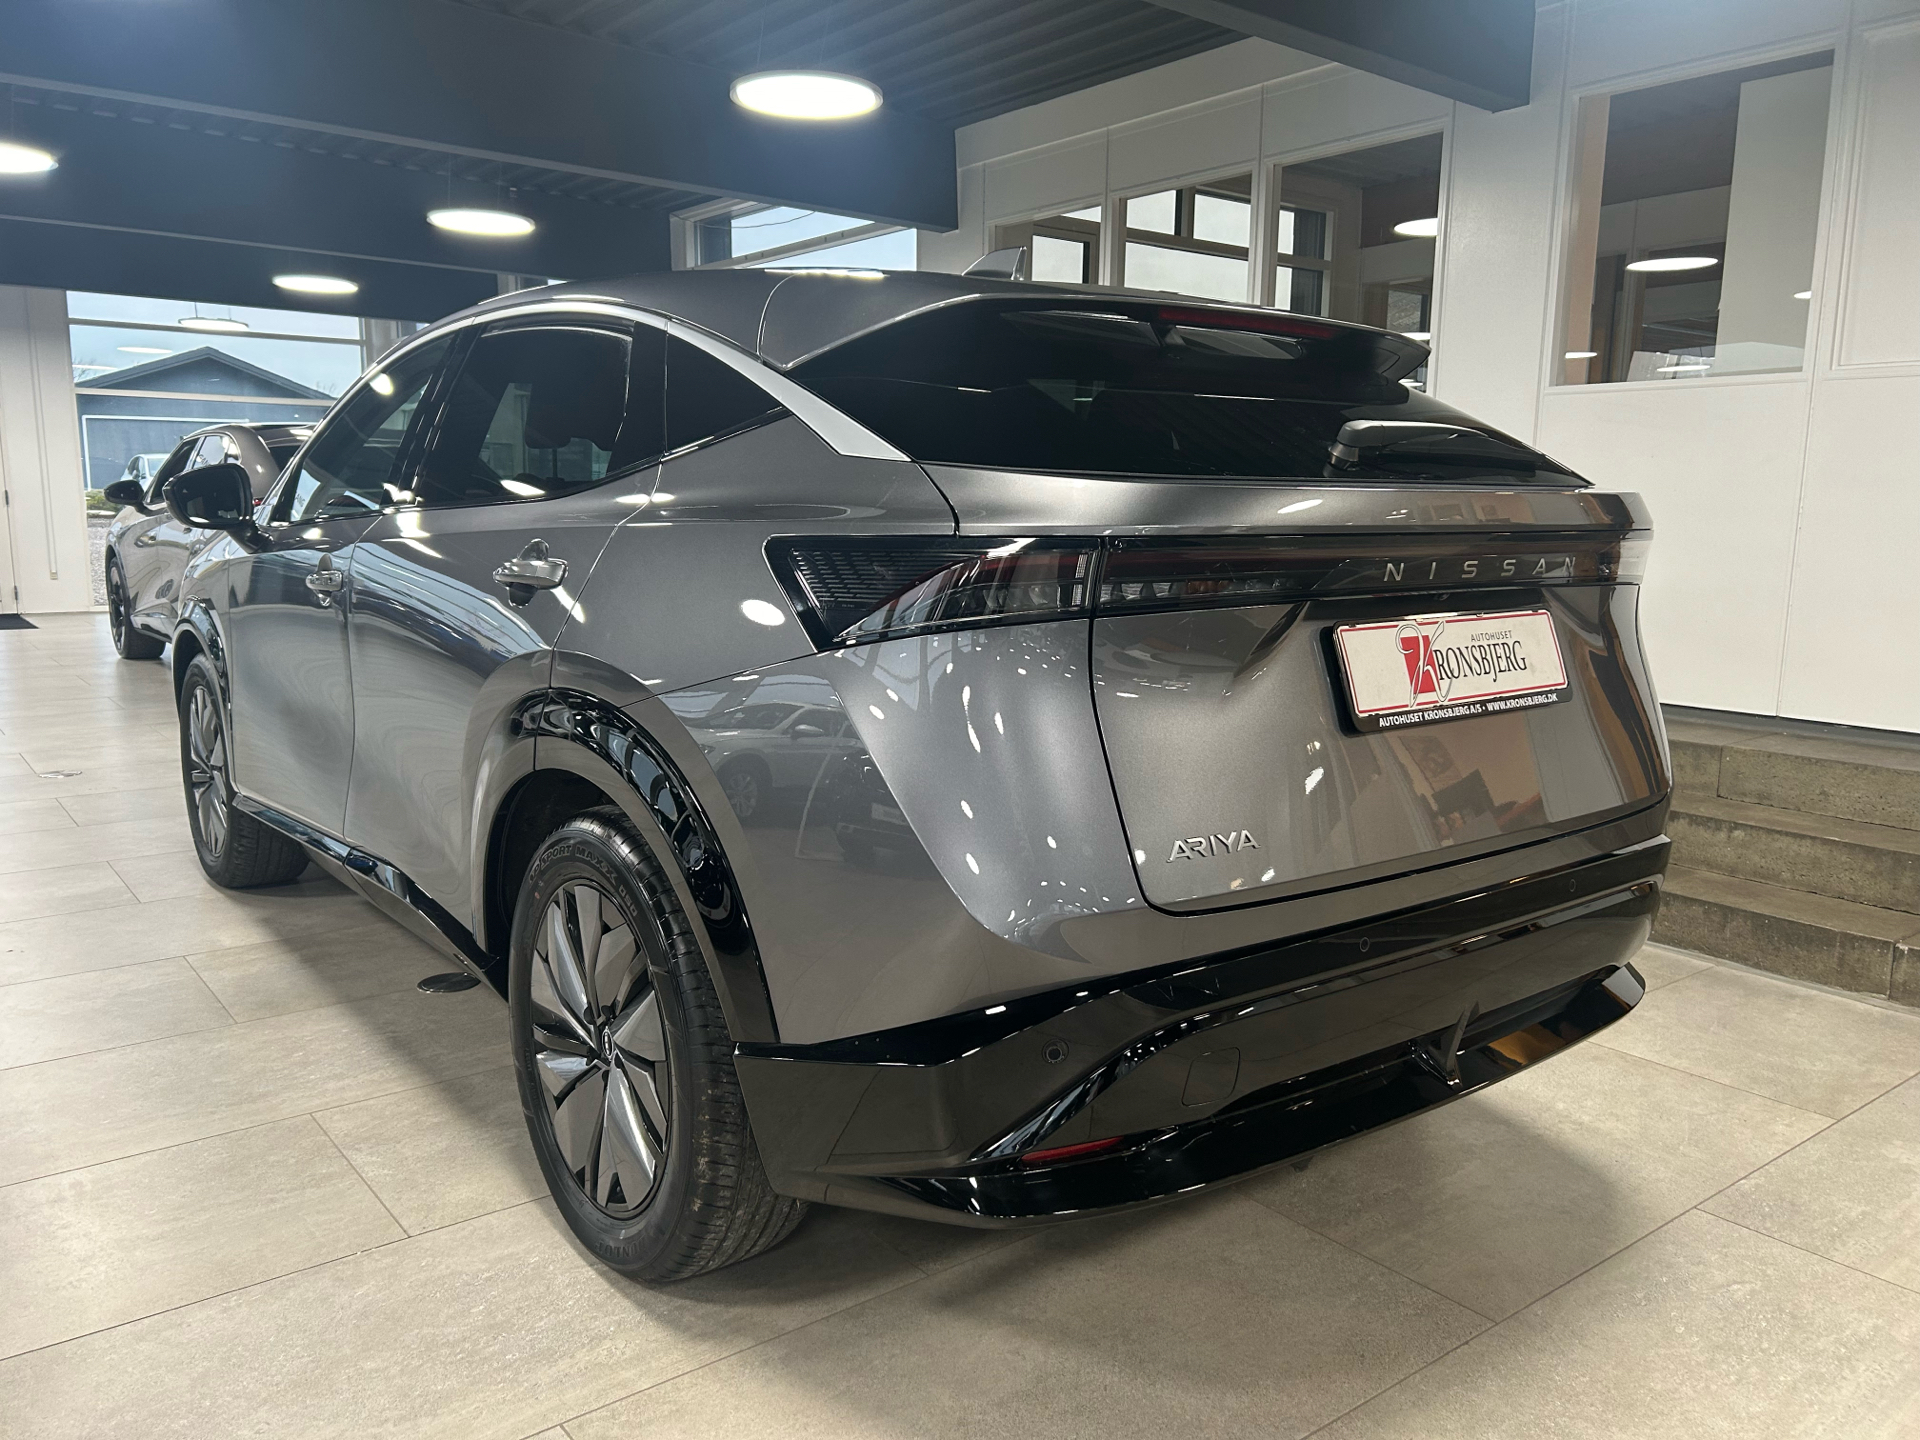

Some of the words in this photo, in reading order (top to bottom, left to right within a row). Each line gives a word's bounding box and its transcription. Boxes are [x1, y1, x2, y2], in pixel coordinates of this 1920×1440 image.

[1383, 556, 1576, 582] NISSAN
[1470, 630, 1513, 642] AUTOHUSET
[1378, 711, 1424, 727] AUTOHUSET
[1424, 706, 1470, 721] KRONSBJERG
[1470, 703, 1483, 715] A/S
[1486, 692, 1559, 712] WWW.KRONSBJERG.DK
[1166, 828, 1262, 863] ARIYA
[575, 844, 619, 885] MAXX
